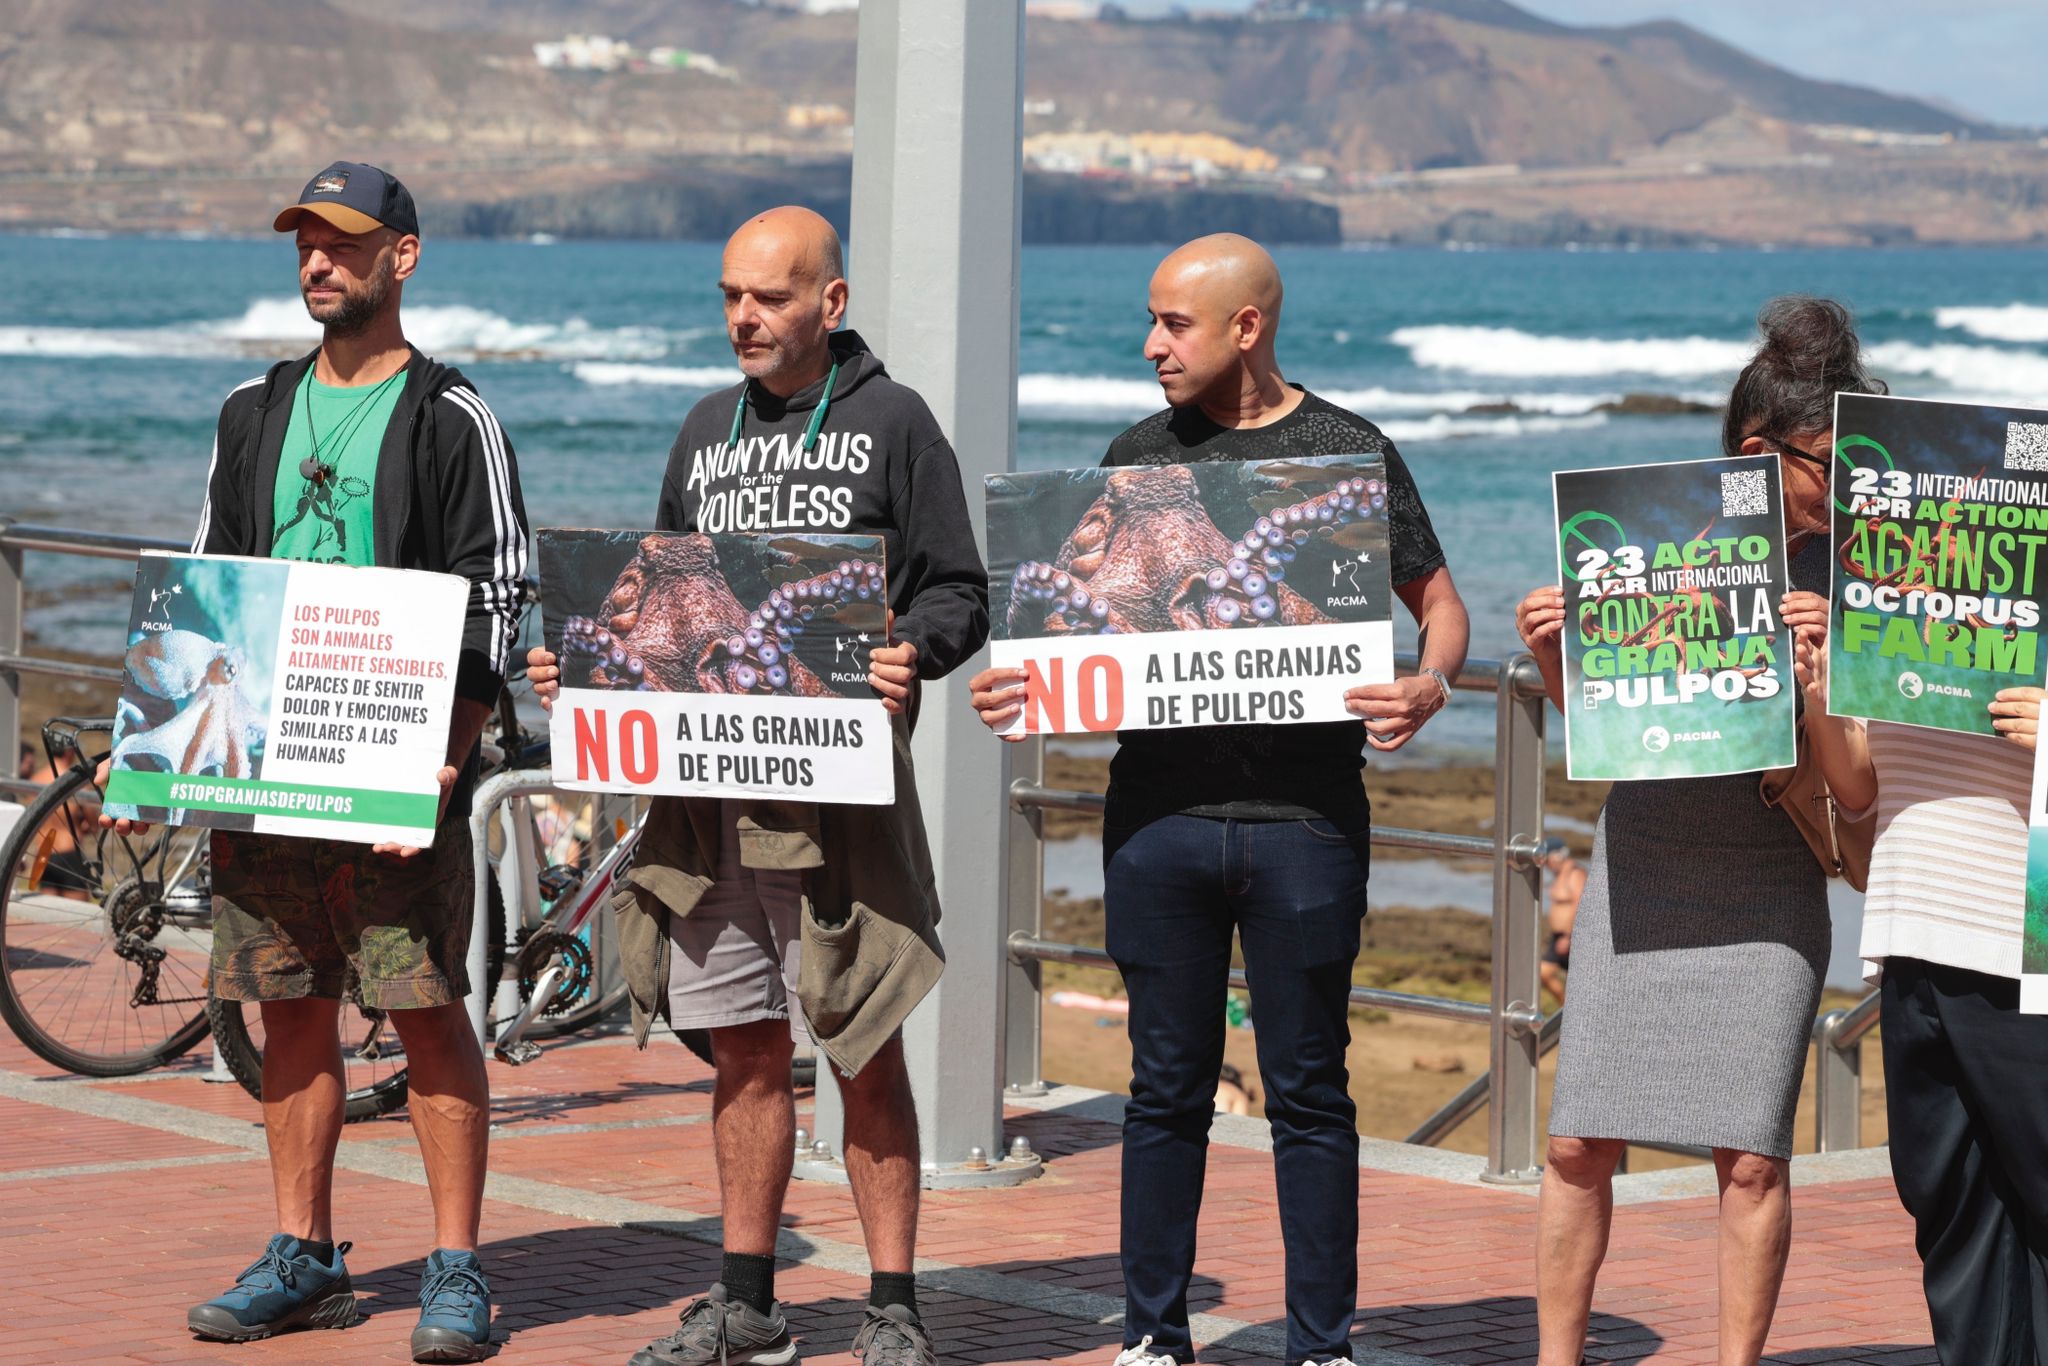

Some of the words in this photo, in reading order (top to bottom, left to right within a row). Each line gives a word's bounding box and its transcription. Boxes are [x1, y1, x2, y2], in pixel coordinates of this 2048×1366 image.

[687, 432, 872, 491] ANONYMOUS
[739, 474, 758, 487] for
[762, 472, 784, 485] the
[1850, 467, 1912, 498] 23
[1916, 473, 2048, 506] INTERNATIONAL
[696, 484, 853, 533] VOICELESS
[1849, 495, 1911, 519] APR
[1915, 499, 2048, 531] ACTION
[1577, 545, 1646, 580] 23
[1652, 535, 1770, 568] ACTO
[1845, 517, 2046, 596] AGAINST
[1578, 577, 1647, 598] ABR
[1652, 564, 1772, 592] INTERNACIONAL
[294, 605, 320, 622] LOS
[324, 607, 380, 627] PULPOS
[1327, 595, 1368, 608] PACMA
[1844, 581, 2040, 628] OCTOPUS
[140, 620, 173, 632] PACMA
[1578, 592, 1720, 647] CONTRA
[1729, 588, 1775, 634] LA
[291, 628, 320, 645] SON
[323, 630, 393, 651] ANIMALES
[1843, 611, 2038, 676] FARM
[288, 650, 366, 672] ALTAMENTE
[369, 657, 447, 681] SENSIBLES,
[1146, 654, 1164, 684] A
[1174, 650, 1225, 682] LAS
[1234, 644, 1362, 680] GRANJAS
[1582, 636, 1776, 678] GRANJA
[286, 674, 348, 694] CAPACES
[353, 679, 370, 696] DE
[375, 680, 424, 700] SENTIR
[831, 672, 868, 683] PACMA
[1584, 668, 1780, 709] PULPOS
[1926, 683, 1972, 698] PACMA
[1023, 654, 1124, 734] NO
[1148, 696, 1182, 726] DE
[1192, 690, 1305, 724] PULPOS
[1585, 685, 1596, 708] DE
[283, 697, 330, 716] DOLOR
[335, 701, 343, 717] Y
[347, 702, 428, 724] EMOCIONES
[280, 720, 354, 742] SIMILARES
[358, 726, 366, 743] A
[372, 728, 398, 745] LAS
[573, 707, 659, 785] NO
[677, 713, 692, 741] A
[701, 713, 744, 743] LAS
[753, 716, 863, 748] GRANJAS
[1673, 730, 1722, 742] PACMA
[276, 743, 345, 764] HUMANAS
[678, 752, 709, 782] DE
[717, 755, 814, 787] PULPOS
[170, 783, 353, 814] #STOPGRANJASDEPULPOS
